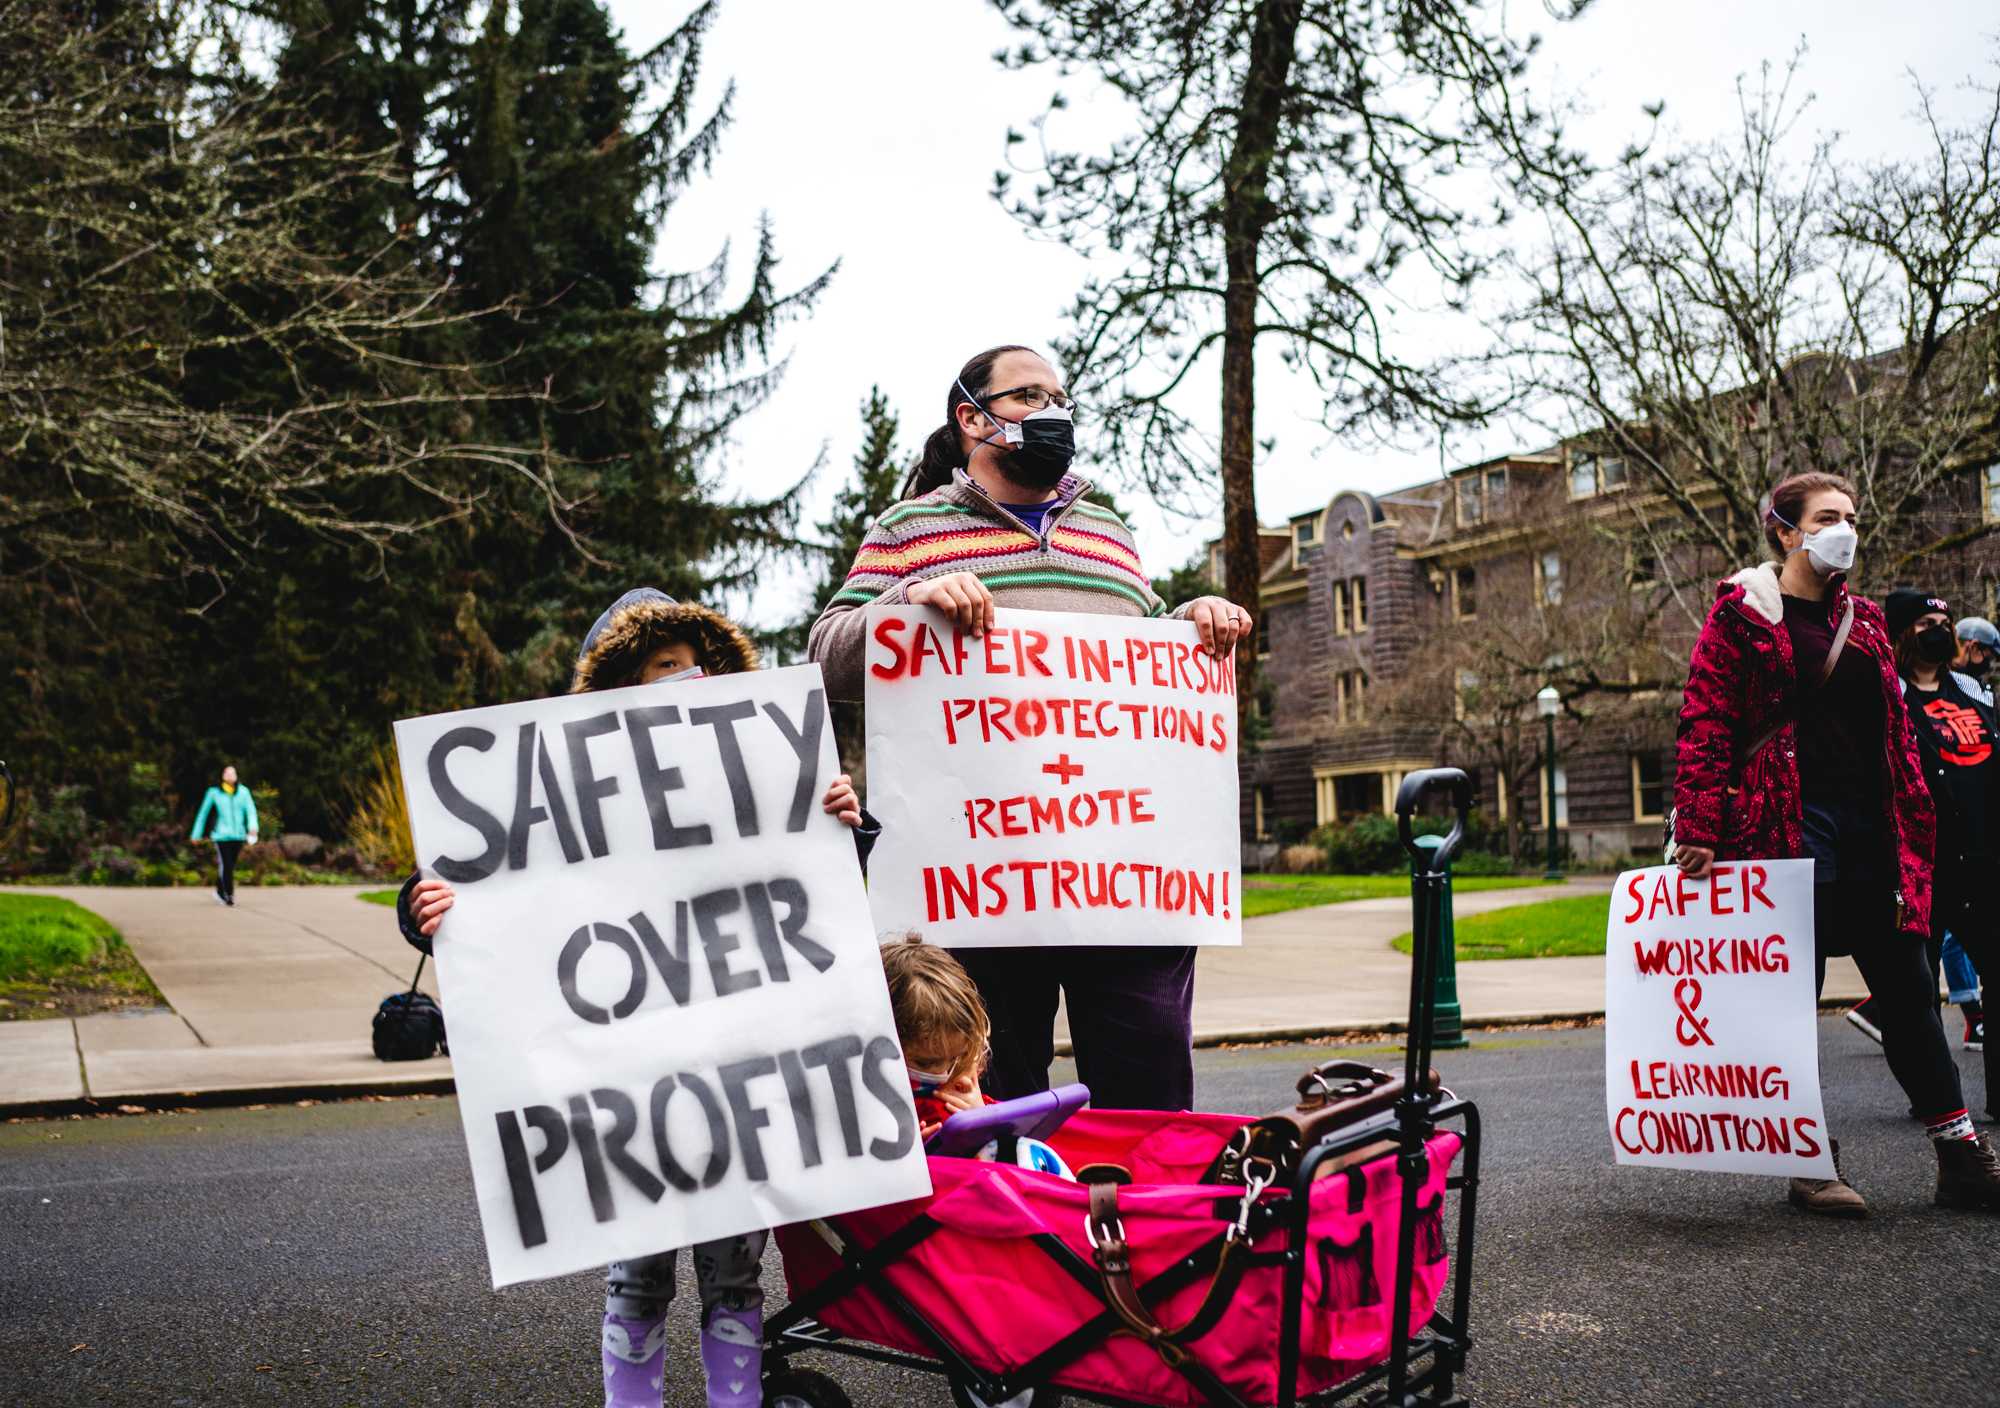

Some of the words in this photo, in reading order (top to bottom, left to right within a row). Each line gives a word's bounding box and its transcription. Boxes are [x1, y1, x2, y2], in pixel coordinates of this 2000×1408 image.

[870, 618, 1054, 681] SAFER
[1063, 637, 1236, 697] IN-PERSON
[943, 698, 1227, 753] PROTECTIONS
[427, 688, 824, 884] SAFETY
[1042, 754, 1084, 785] +
[964, 788, 1156, 839] REMOTE
[922, 860, 1231, 924] INSTRUCTION!
[1625, 866, 1776, 923] SAFER
[557, 878, 836, 1025] OVER
[1634, 934, 1790, 976] WORKING
[1673, 978, 1715, 1047] &
[1631, 1060, 1789, 1101] LEARNING
[495, 1034, 914, 1250] PROFITS
[1615, 1107, 1822, 1159] CONDITIONS
